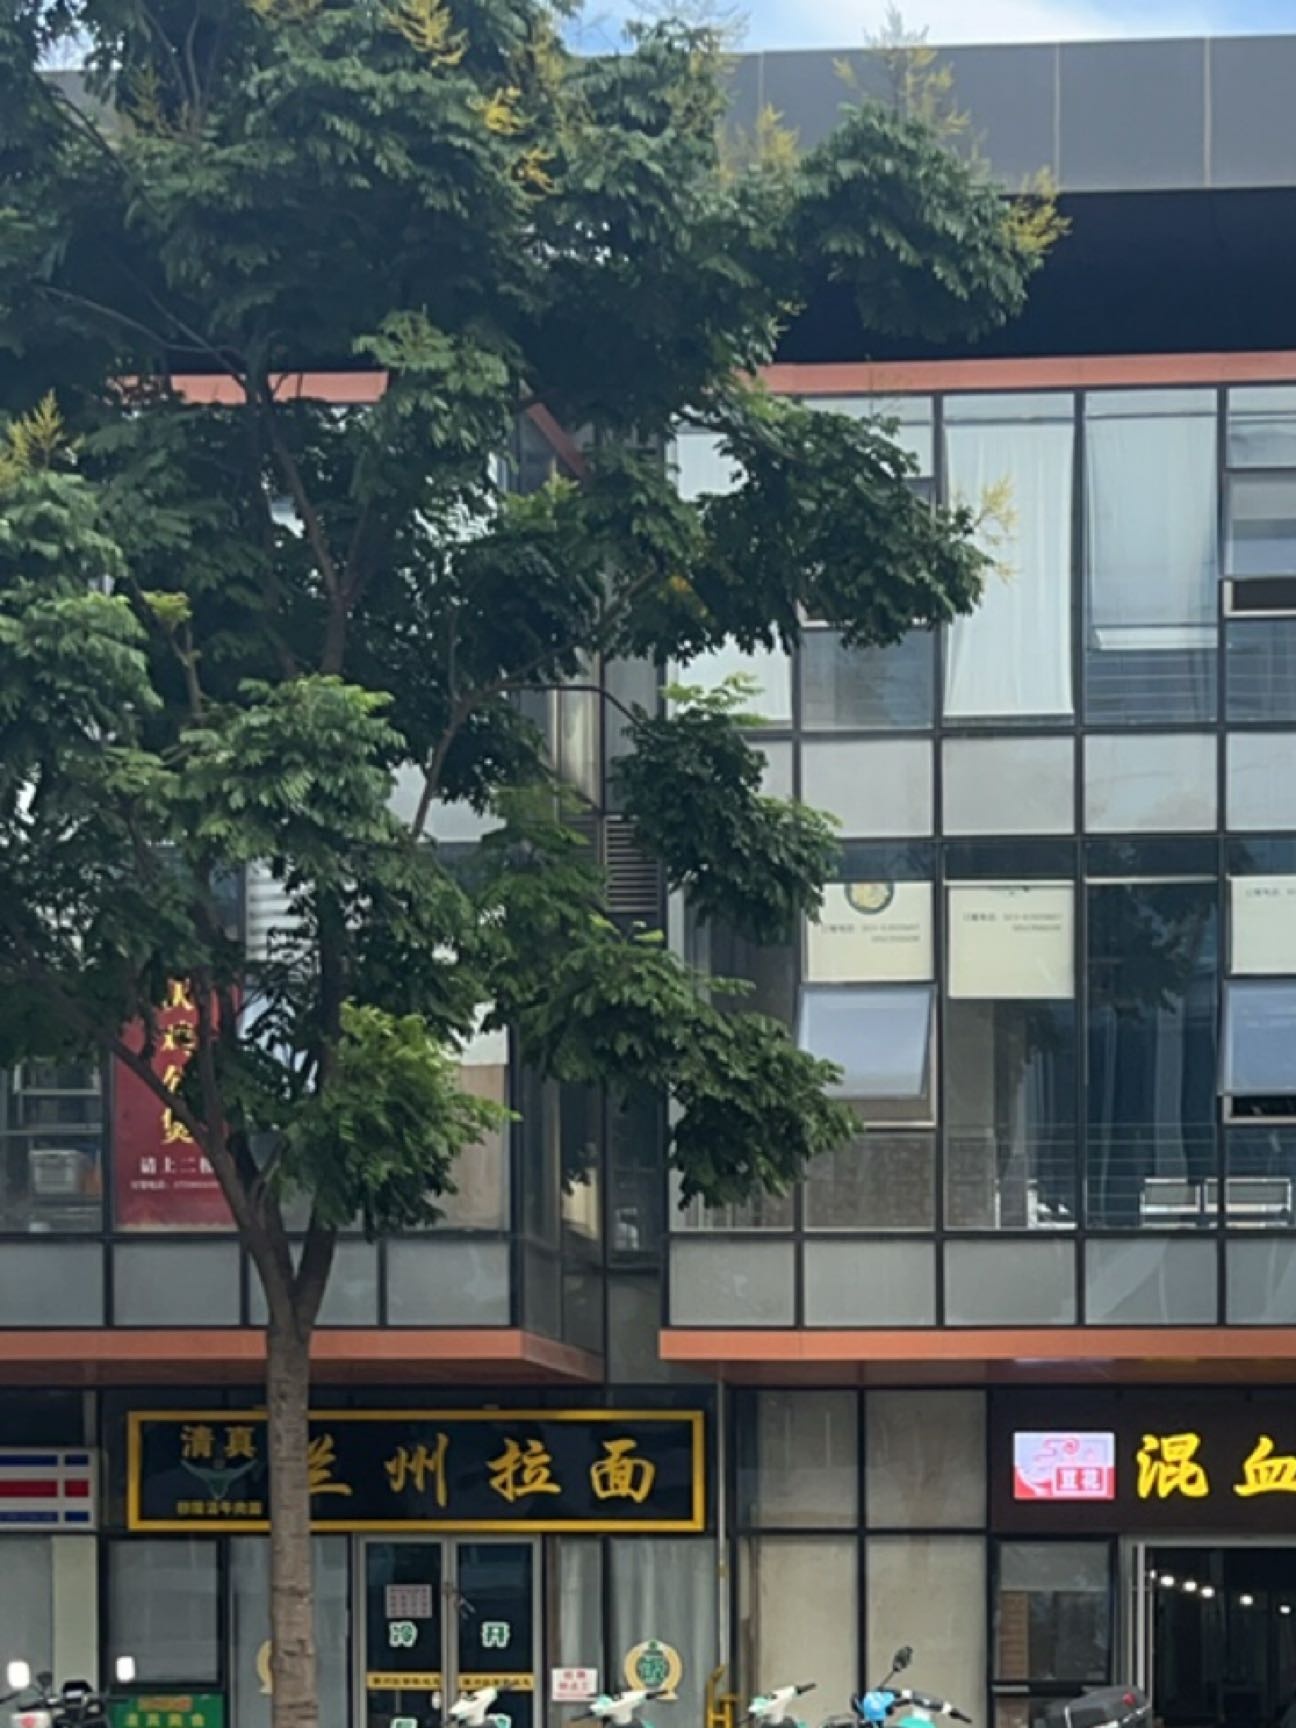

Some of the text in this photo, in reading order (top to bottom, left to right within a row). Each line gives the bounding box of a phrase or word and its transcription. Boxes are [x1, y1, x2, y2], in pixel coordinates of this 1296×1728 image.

[181, 1425, 257, 1458] 清真
[308, 1432, 655, 1507] 兰州拉面
